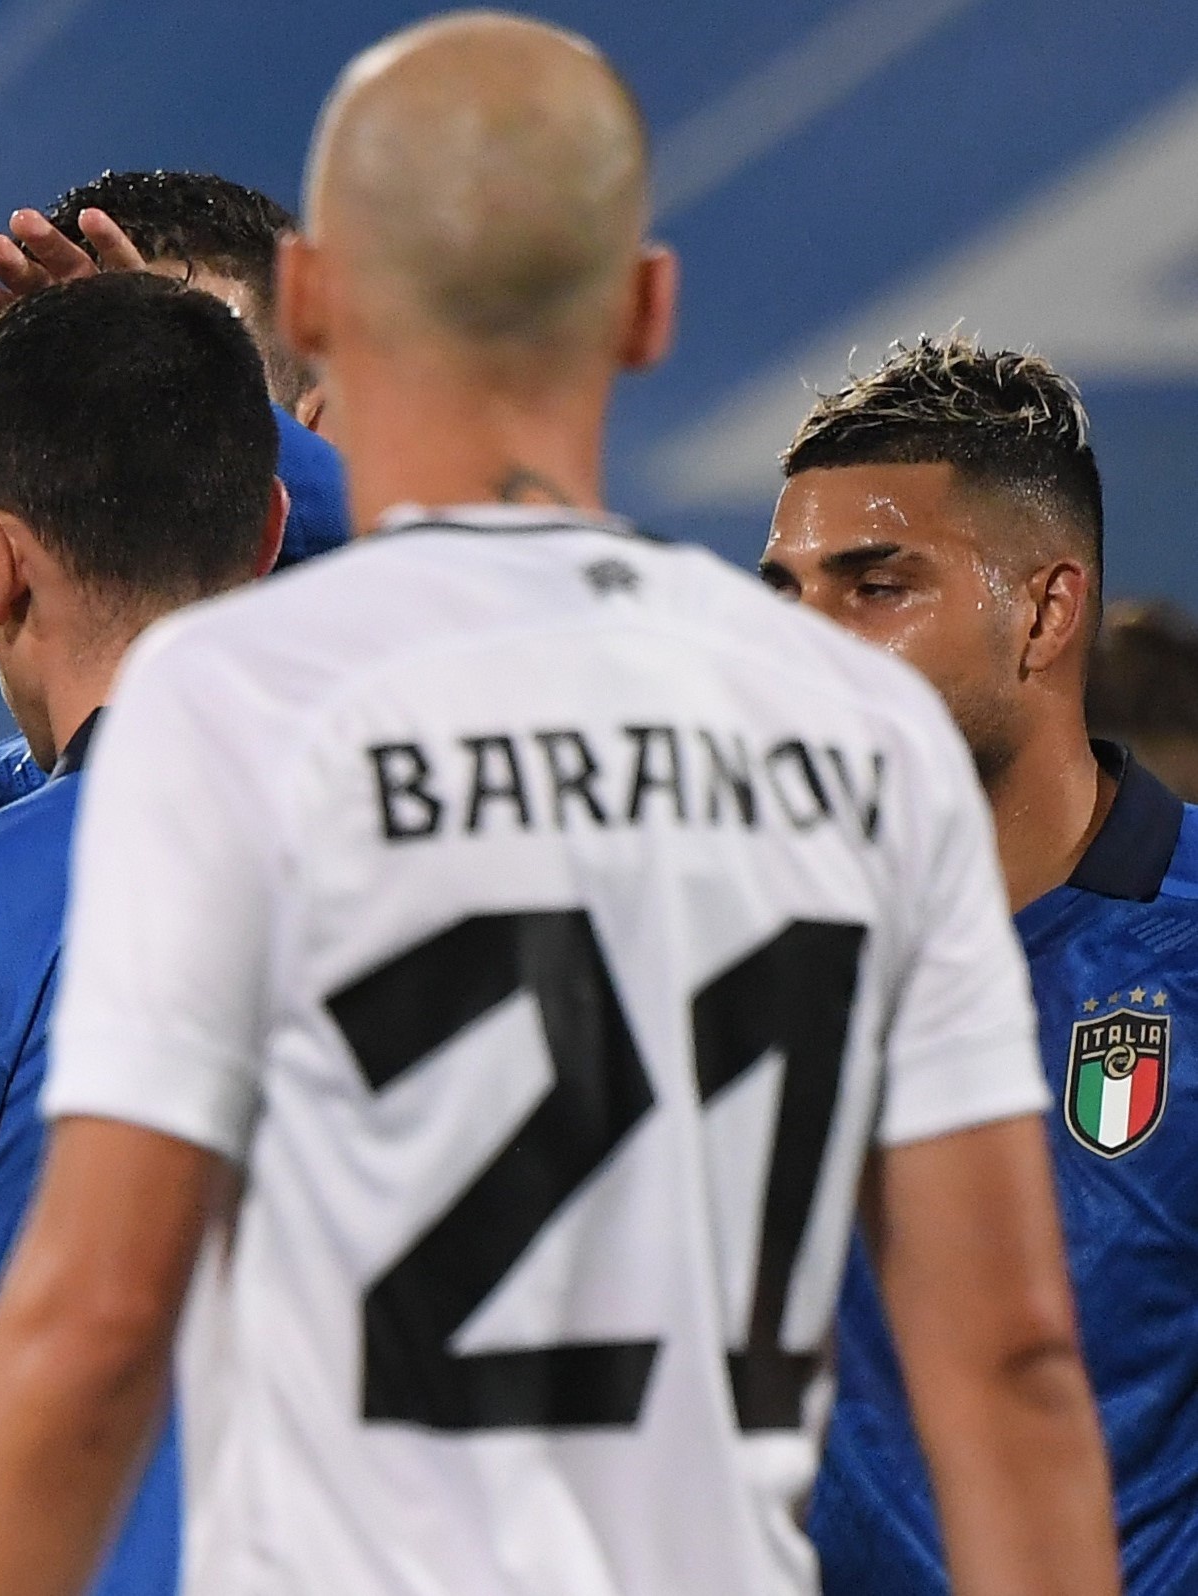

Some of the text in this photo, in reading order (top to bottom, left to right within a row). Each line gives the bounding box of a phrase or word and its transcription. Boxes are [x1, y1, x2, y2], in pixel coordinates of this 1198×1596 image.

[367, 726, 885, 844] BARANOV
[1083, 1025, 1161, 1050] ITALIA
[325, 908, 868, 1432] 21
